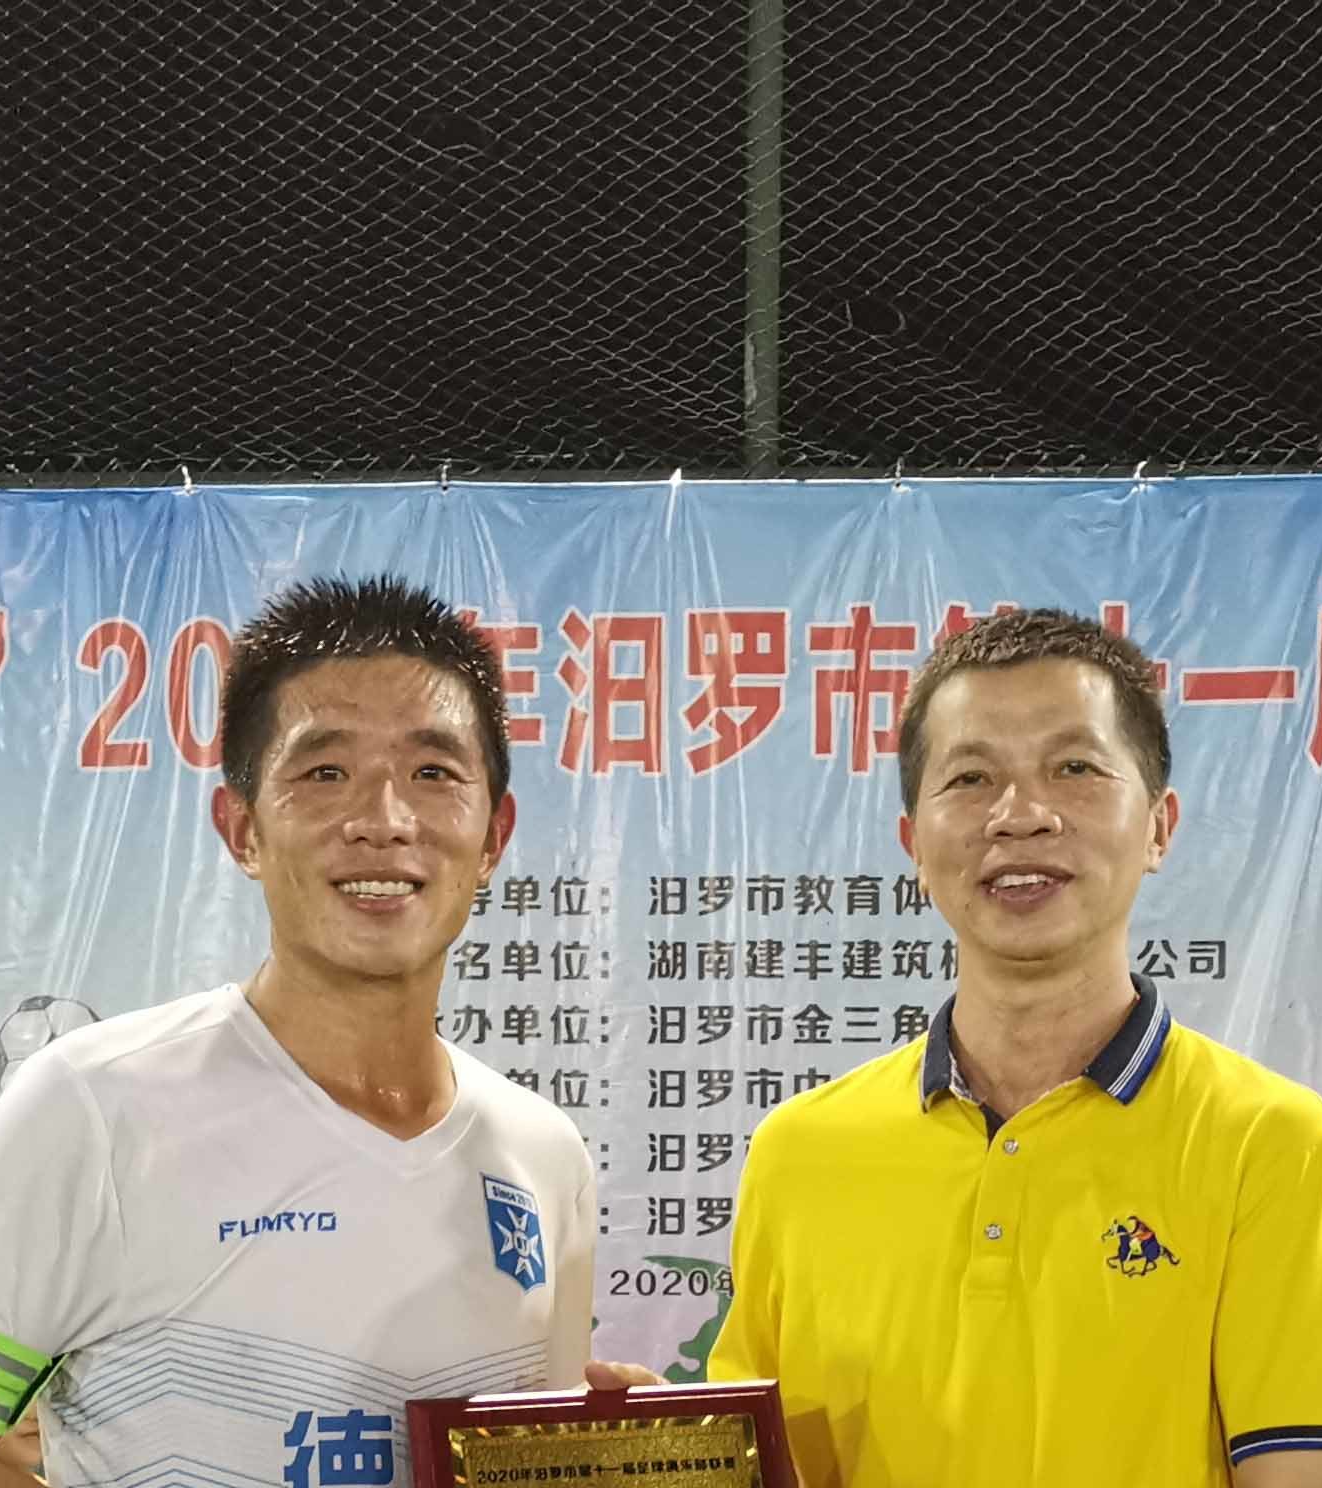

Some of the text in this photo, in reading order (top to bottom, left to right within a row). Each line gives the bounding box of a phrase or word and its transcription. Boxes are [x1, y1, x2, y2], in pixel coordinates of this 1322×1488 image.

[435, 1003, 930, 1046] 办单位：汨罗市金三角
